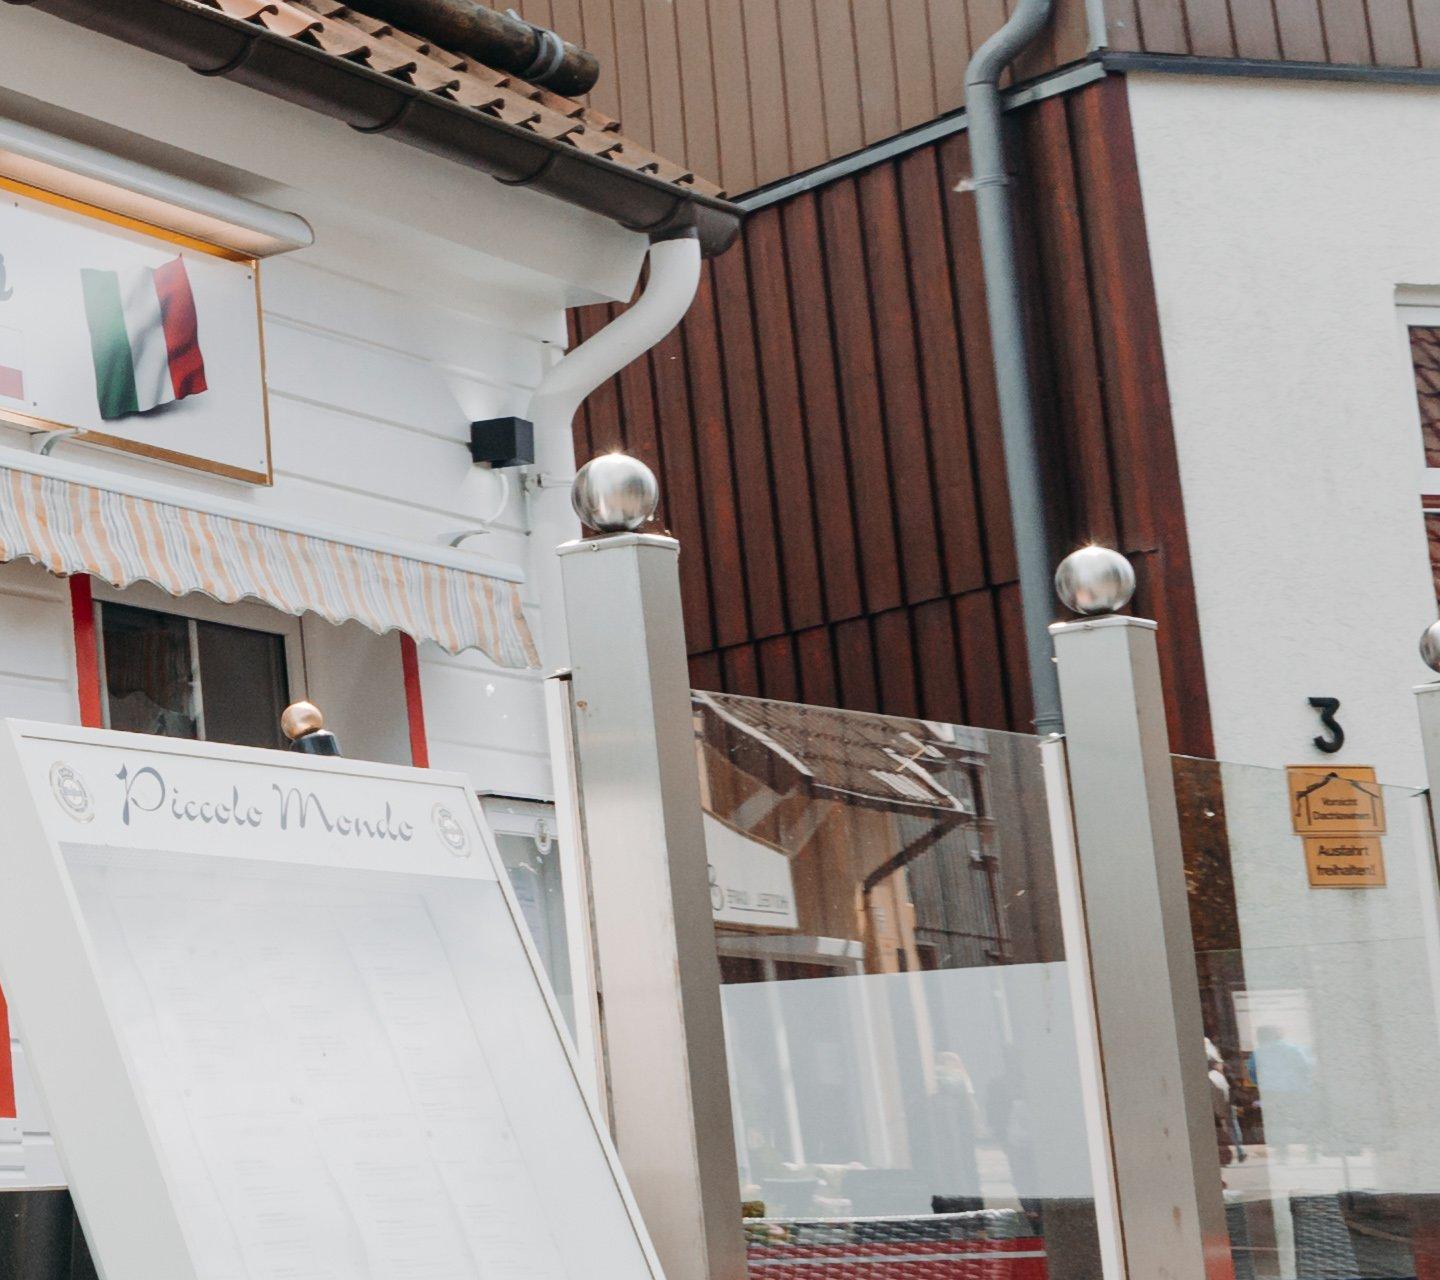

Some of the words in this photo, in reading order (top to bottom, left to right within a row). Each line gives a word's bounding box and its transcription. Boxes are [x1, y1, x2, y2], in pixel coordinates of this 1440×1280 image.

[1306, 697, 1345, 754] 3
[114, 762, 264, 827] Piccolo
[271, 782, 415, 842] Mondo
[1317, 843, 1370, 858] Ausfahrt
